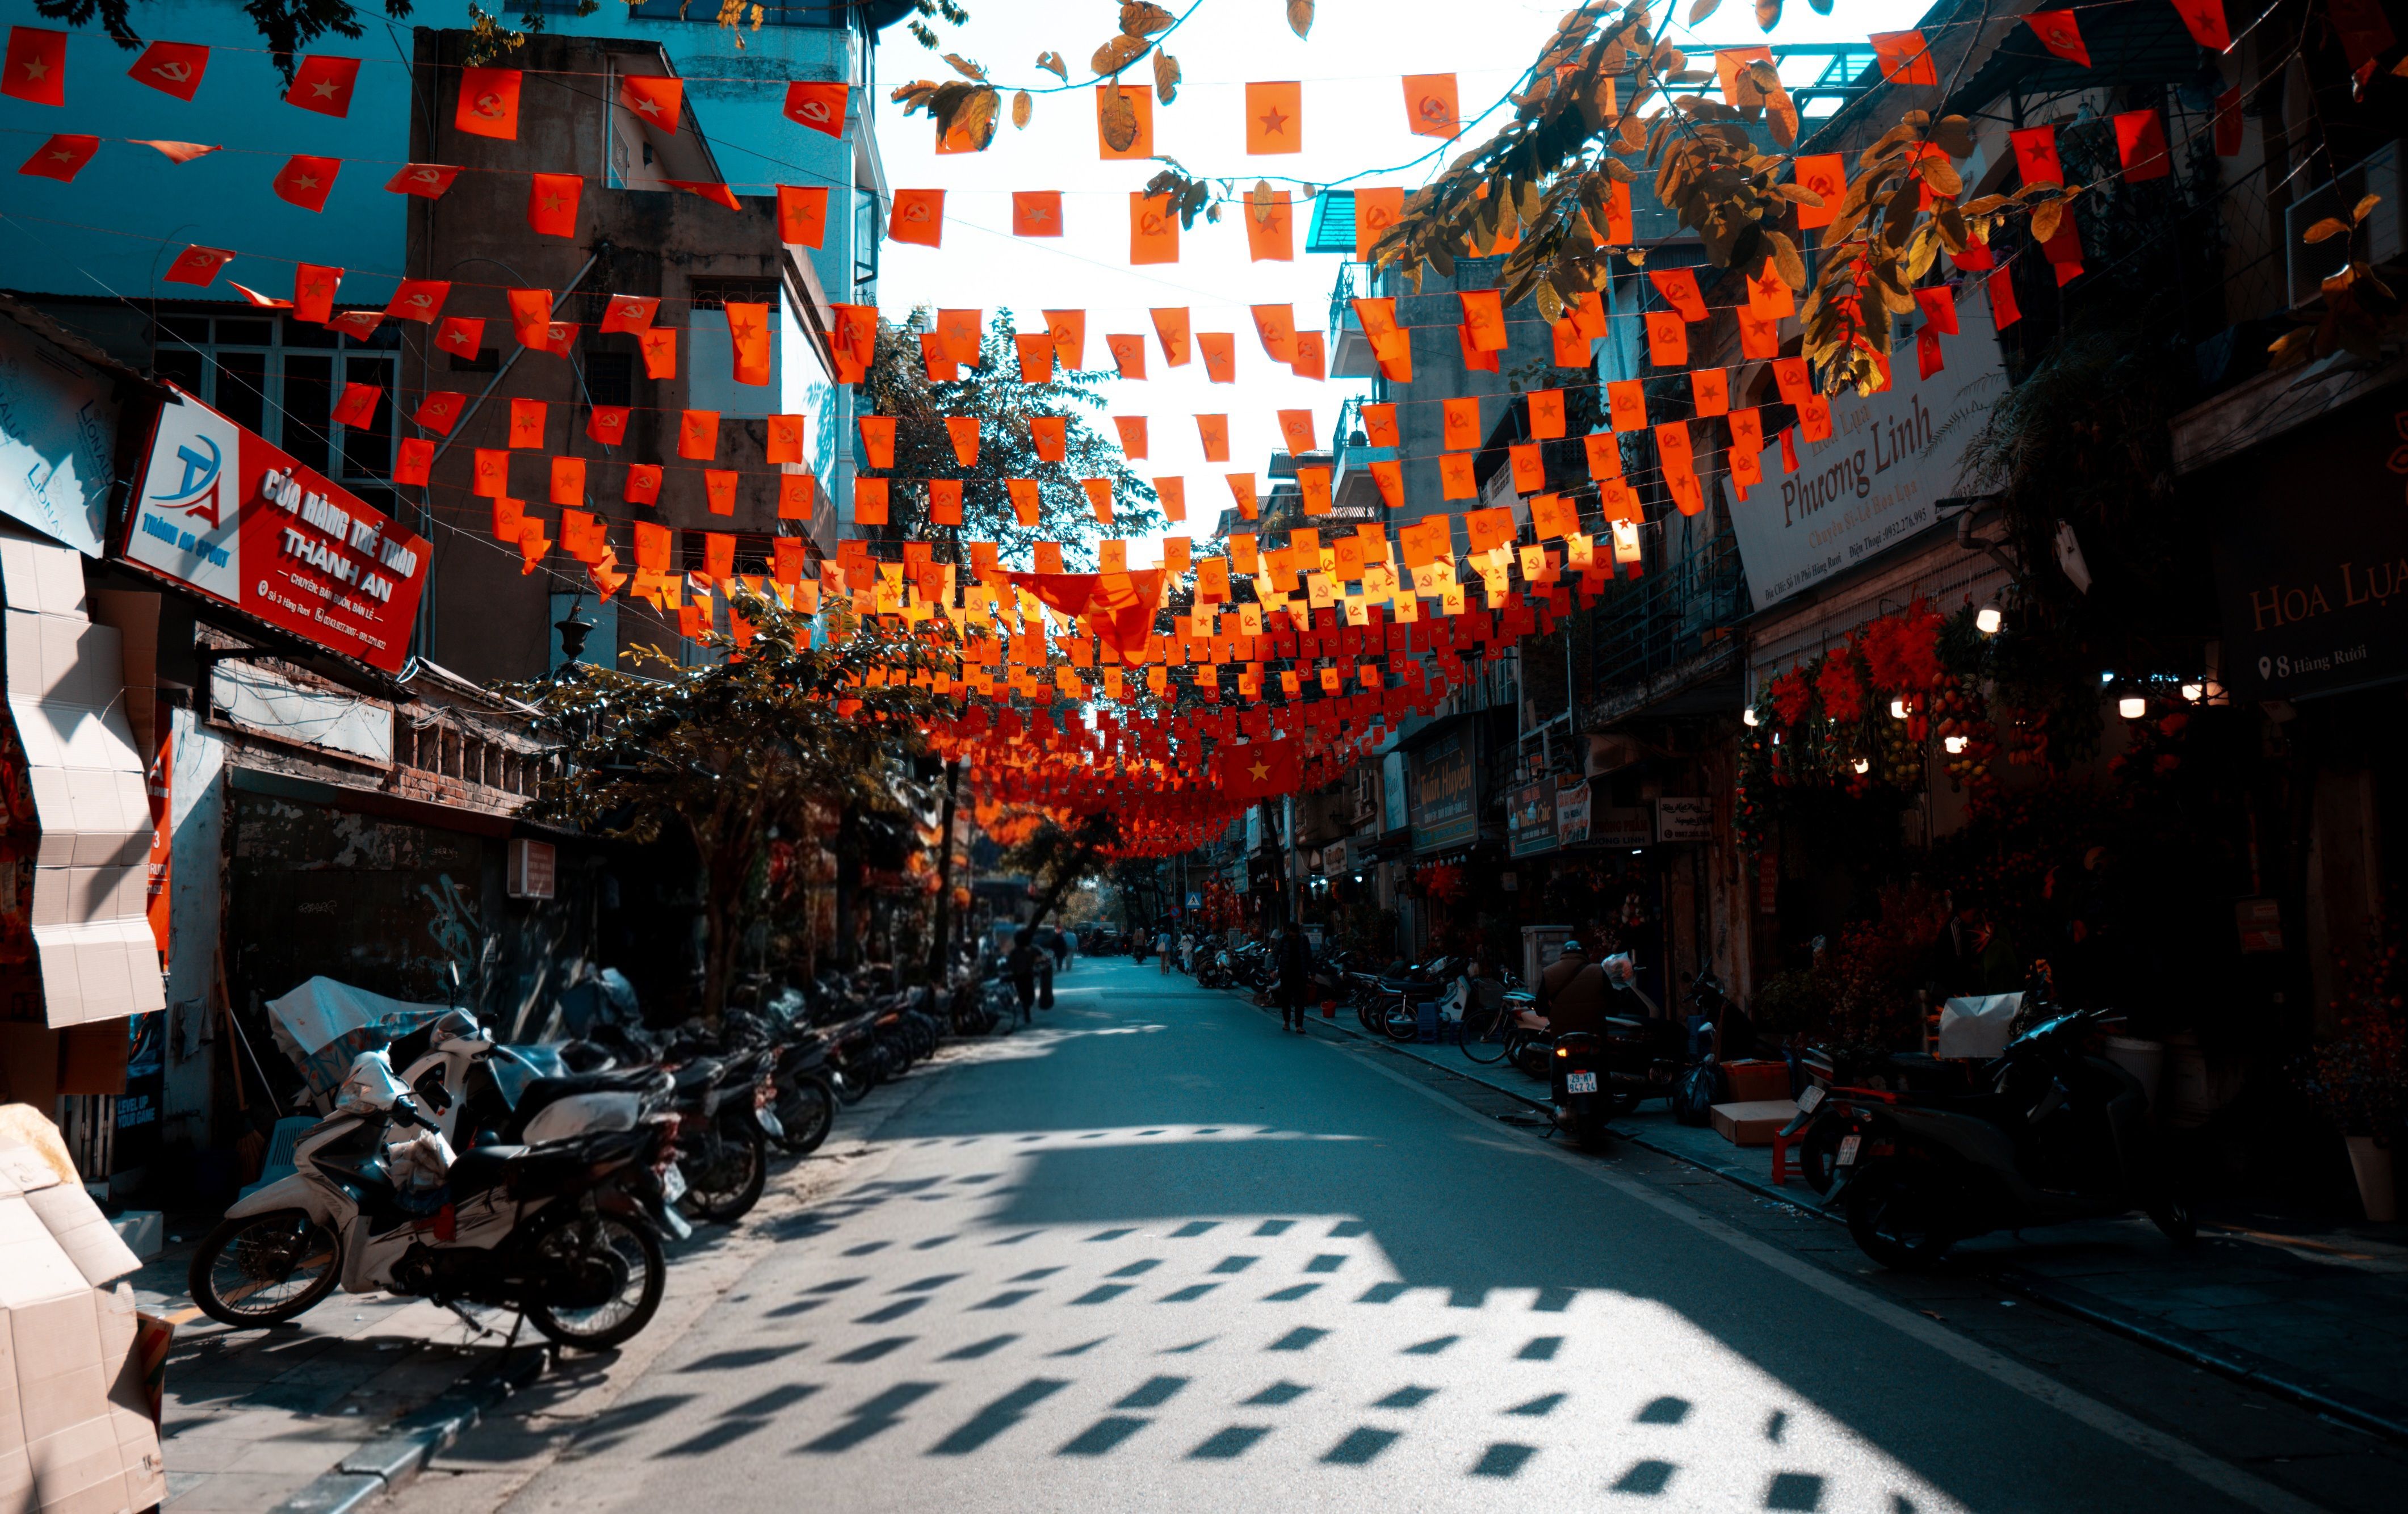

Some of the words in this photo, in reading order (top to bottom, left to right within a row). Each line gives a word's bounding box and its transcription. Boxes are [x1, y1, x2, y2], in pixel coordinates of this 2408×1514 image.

[1781, 448, 1870, 528] Phương
[1870, 393, 1932, 475] Linh
[262, 467, 301, 514] CỬA
[300, 491, 350, 541] HÀNG
[349, 518, 384, 558] THỂ
[379, 536, 417, 578] THAO
[196, 539, 230, 568] SPORT
[1849, 543, 1863, 559] Điện
[1864, 531, 1882, 548] Thoại
[284, 526, 360, 586] THÀNH
[360, 572, 393, 602] AN
[1794, 573, 1801, 585] 10
[1812, 563, 1827, 577] Hàng
[267, 590, 277, 602] Số
[277, 594, 282, 604] 3
[282, 597, 296, 613] Hàng
[318, 585, 333, 601] BÁN
[352, 601, 366, 616] BÁN
[2276, 655, 2290, 679] 8
[2294, 657, 2330, 674] Hàng
[1420, 765, 1440, 806] Tuấn
[1442, 747, 1471, 802] Huyền
[153, 831, 160, 848] 3
[117, 1097, 138, 1115] LEVEL
[138, 1094, 149, 1111] UP
[117, 1112, 136, 1130] YOUR
[136, 1107, 156, 1125] GAME
